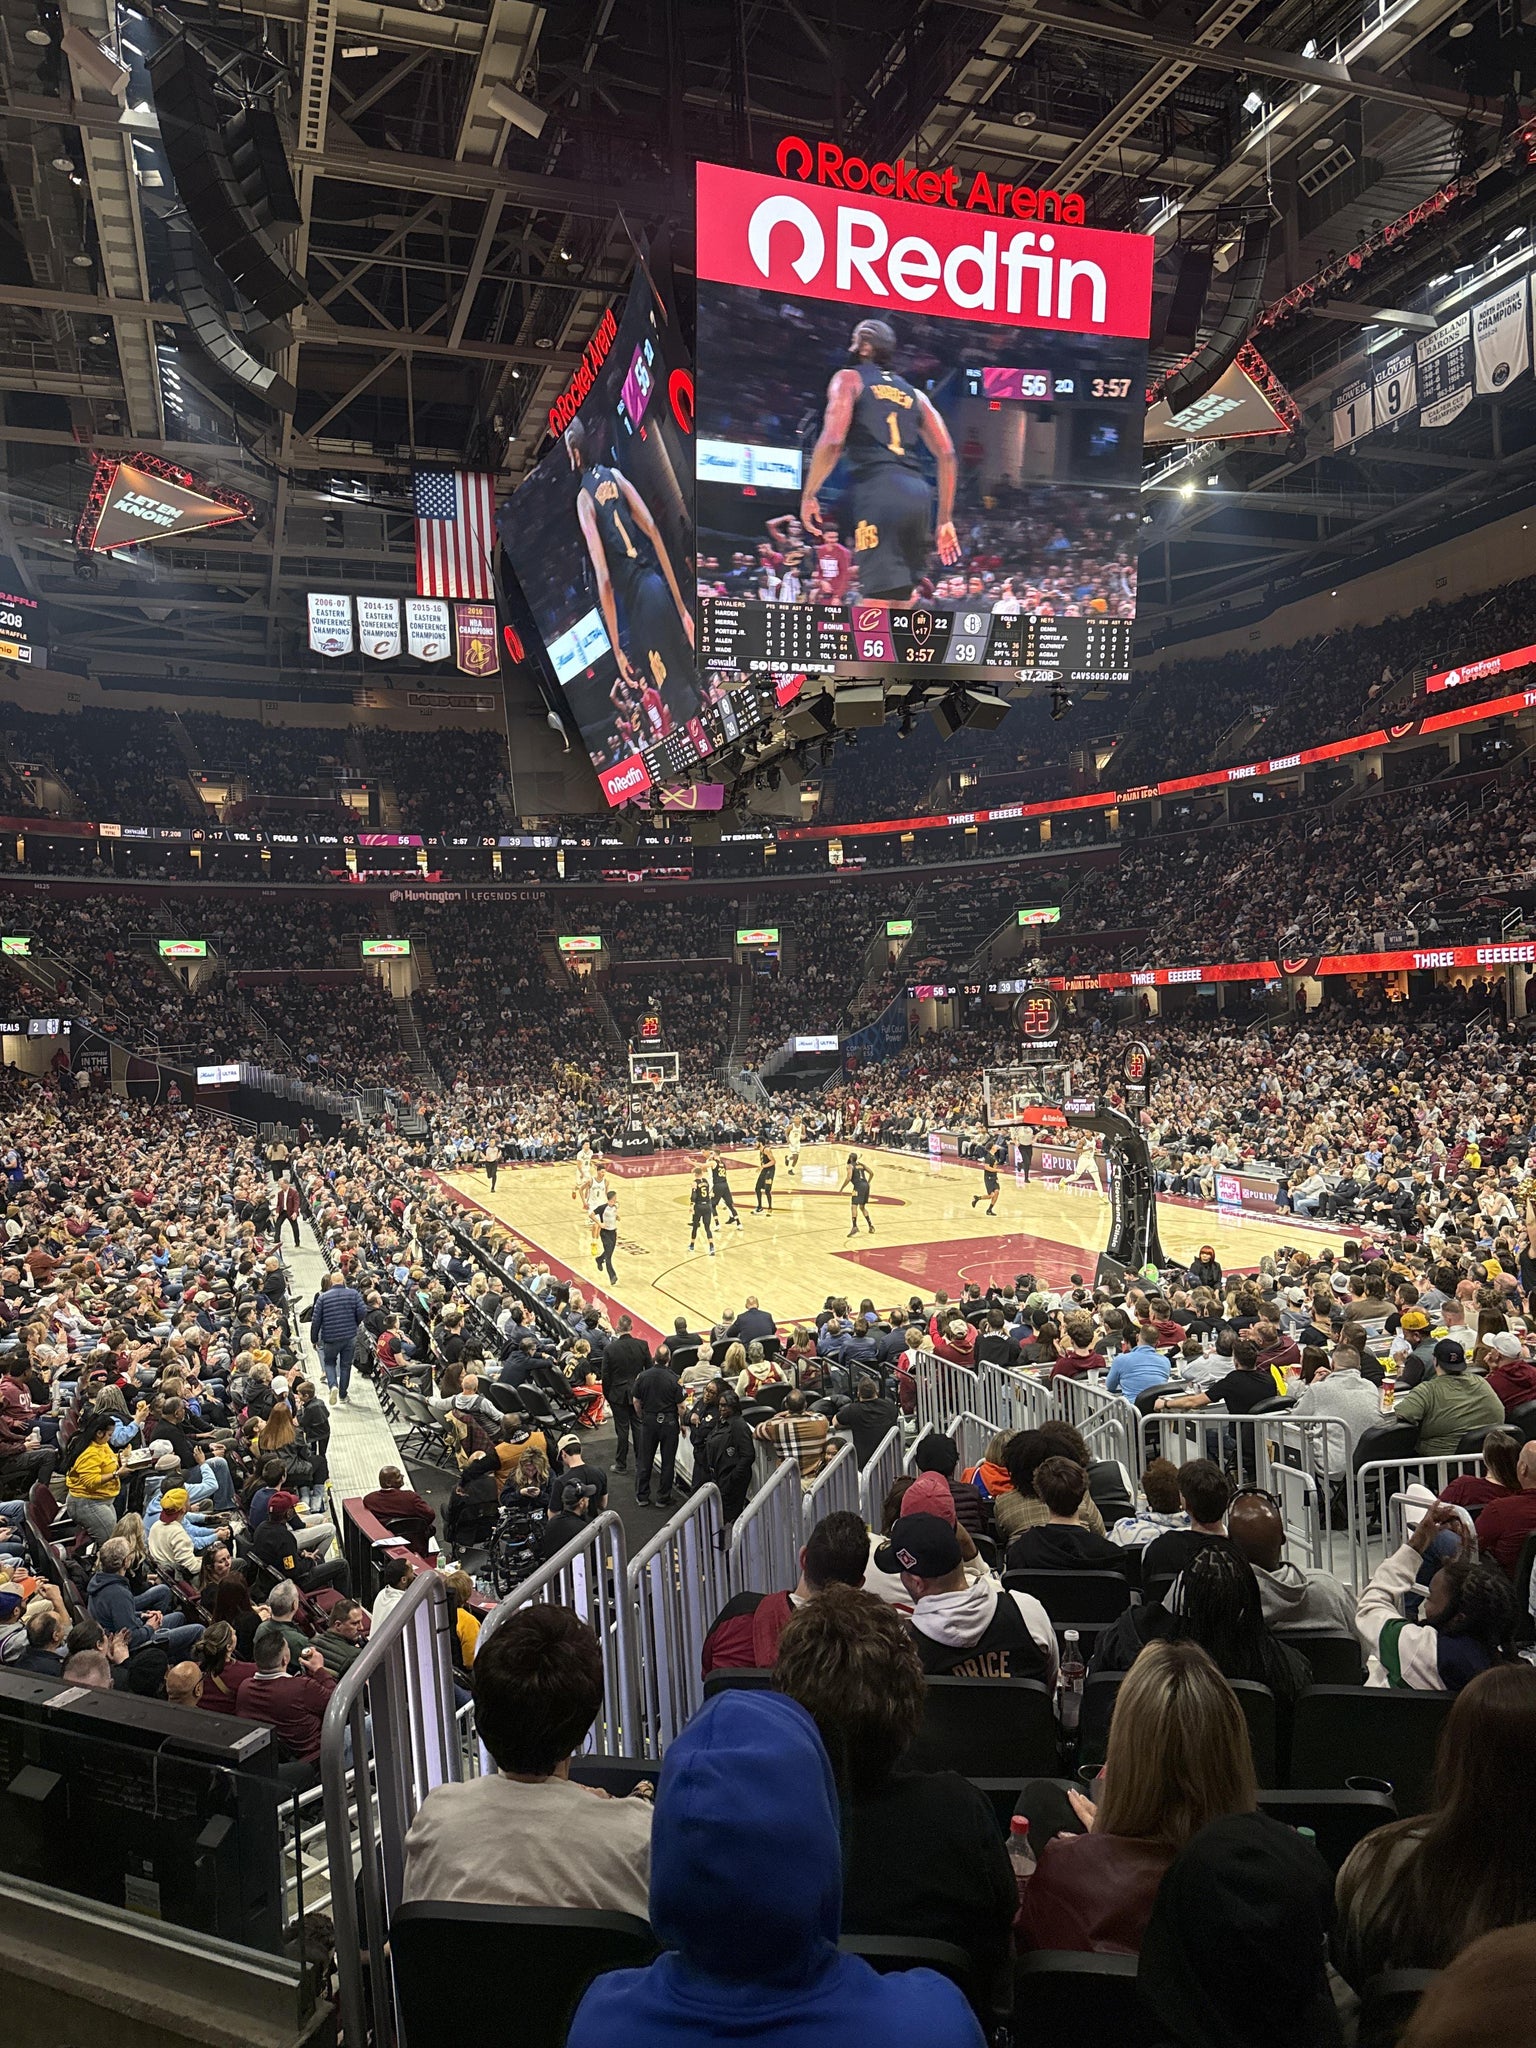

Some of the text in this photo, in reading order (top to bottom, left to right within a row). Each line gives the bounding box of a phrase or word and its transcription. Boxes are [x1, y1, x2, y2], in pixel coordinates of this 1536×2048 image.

[818, 142, 1085, 224] Rocket Arena
[837, 205, 1106, 322] Redfin
[1479, 291, 1519, 319] NORTH DIVISION
[1478, 299, 1522, 332] CHAMPIONS
[1418, 316, 1467, 350] CLEVELAND
[1427, 331, 1460, 355] BARONS
[557, 353, 595, 419] Rocket
[588, 308, 616, 367] Arena
[1387, 356, 1400, 367] FRED
[1376, 356, 1411, 382] GLOVER
[1022, 375, 1046, 396] 56
[1055, 380, 1074, 393] 2Q
[1092, 378, 1132, 398] 3:57
[1337, 382, 1367, 405] BOWER
[1388, 380, 1400, 415] 9
[1164, 394, 1224, 428] LET EM
[1180, 398, 1246, 432] KNOW.
[1347, 404, 1355, 438] 1
[886, 412, 904, 455] 1
[124, 492, 184, 518] LET EM
[113, 500, 174, 528] KNOW.
[0, 592, 38, 608] RAFFLE
[314, 598, 345, 607] 2006-07
[364, 602, 393, 610] 2014-15
[316, 609, 345, 618] EASTERN
[412, 604, 442, 612] 2015-16
[0, 612, 22, 628] 208
[312, 618, 351, 626] CONFERENCE
[366, 612, 392, 620] EASTERN
[414, 614, 441, 622] EASTERN
[894, 617, 908, 628] 2Q
[361, 621, 398, 629] CONFERENCE
[410, 622, 447, 631] CONFERENCE
[935, 619, 947, 628] 22
[314, 626, 350, 635] CHAMPIONS
[363, 629, 397, 638] CHAMPIONS
[412, 631, 446, 640] CHAMPIONS
[459, 626, 493, 636] CHAMPIONS
[863, 640, 884, 658] 56
[906, 648, 935, 662] 3:57
[956, 644, 976, 661] 39
[708, 656, 736, 666] oswald
[792, 663, 835, 672] RAFFLE
[1462, 658, 1500, 676] ForeFront
[1020, 670, 1129, 682] $7,208 CAVS5050.COM
[726, 722, 735, 735] 39
[699, 739, 708, 752] 56
[616, 767, 643, 791] Redfin
[1228, 766, 1256, 780] THREE
[398, 836, 410, 844] 56
[406, 890, 460, 904] Huntington
[472, 892, 517, 900] LEGENDS
[1413, 946, 1535, 968] THREE EEEEEEE
[1131, 972, 1155, 984] THREE
[1002, 984, 1010, 992] 39
[1028, 999, 1050, 1010] 3:57
[34, 1023, 38, 1032] 2
[1024, 1012, 1049, 1032] 22
[642, 1024, 658, 1036] 22
[81, 1057, 108, 1065] IN THE
[1131, 1065, 1142, 1076] 22
[1065, 1101, 1095, 1113] drug mart
[1052, 1158, 1076, 1172] PURI
[718, 1168, 726, 1177] 32
[701, 1187, 707, 1197] 5
[1219, 1181, 1236, 1192] drug
[1221, 1192, 1240, 1200] mart
[1112, 1223, 1120, 1247] Clinic
[952, 1651, 1011, 1678] PRICE
